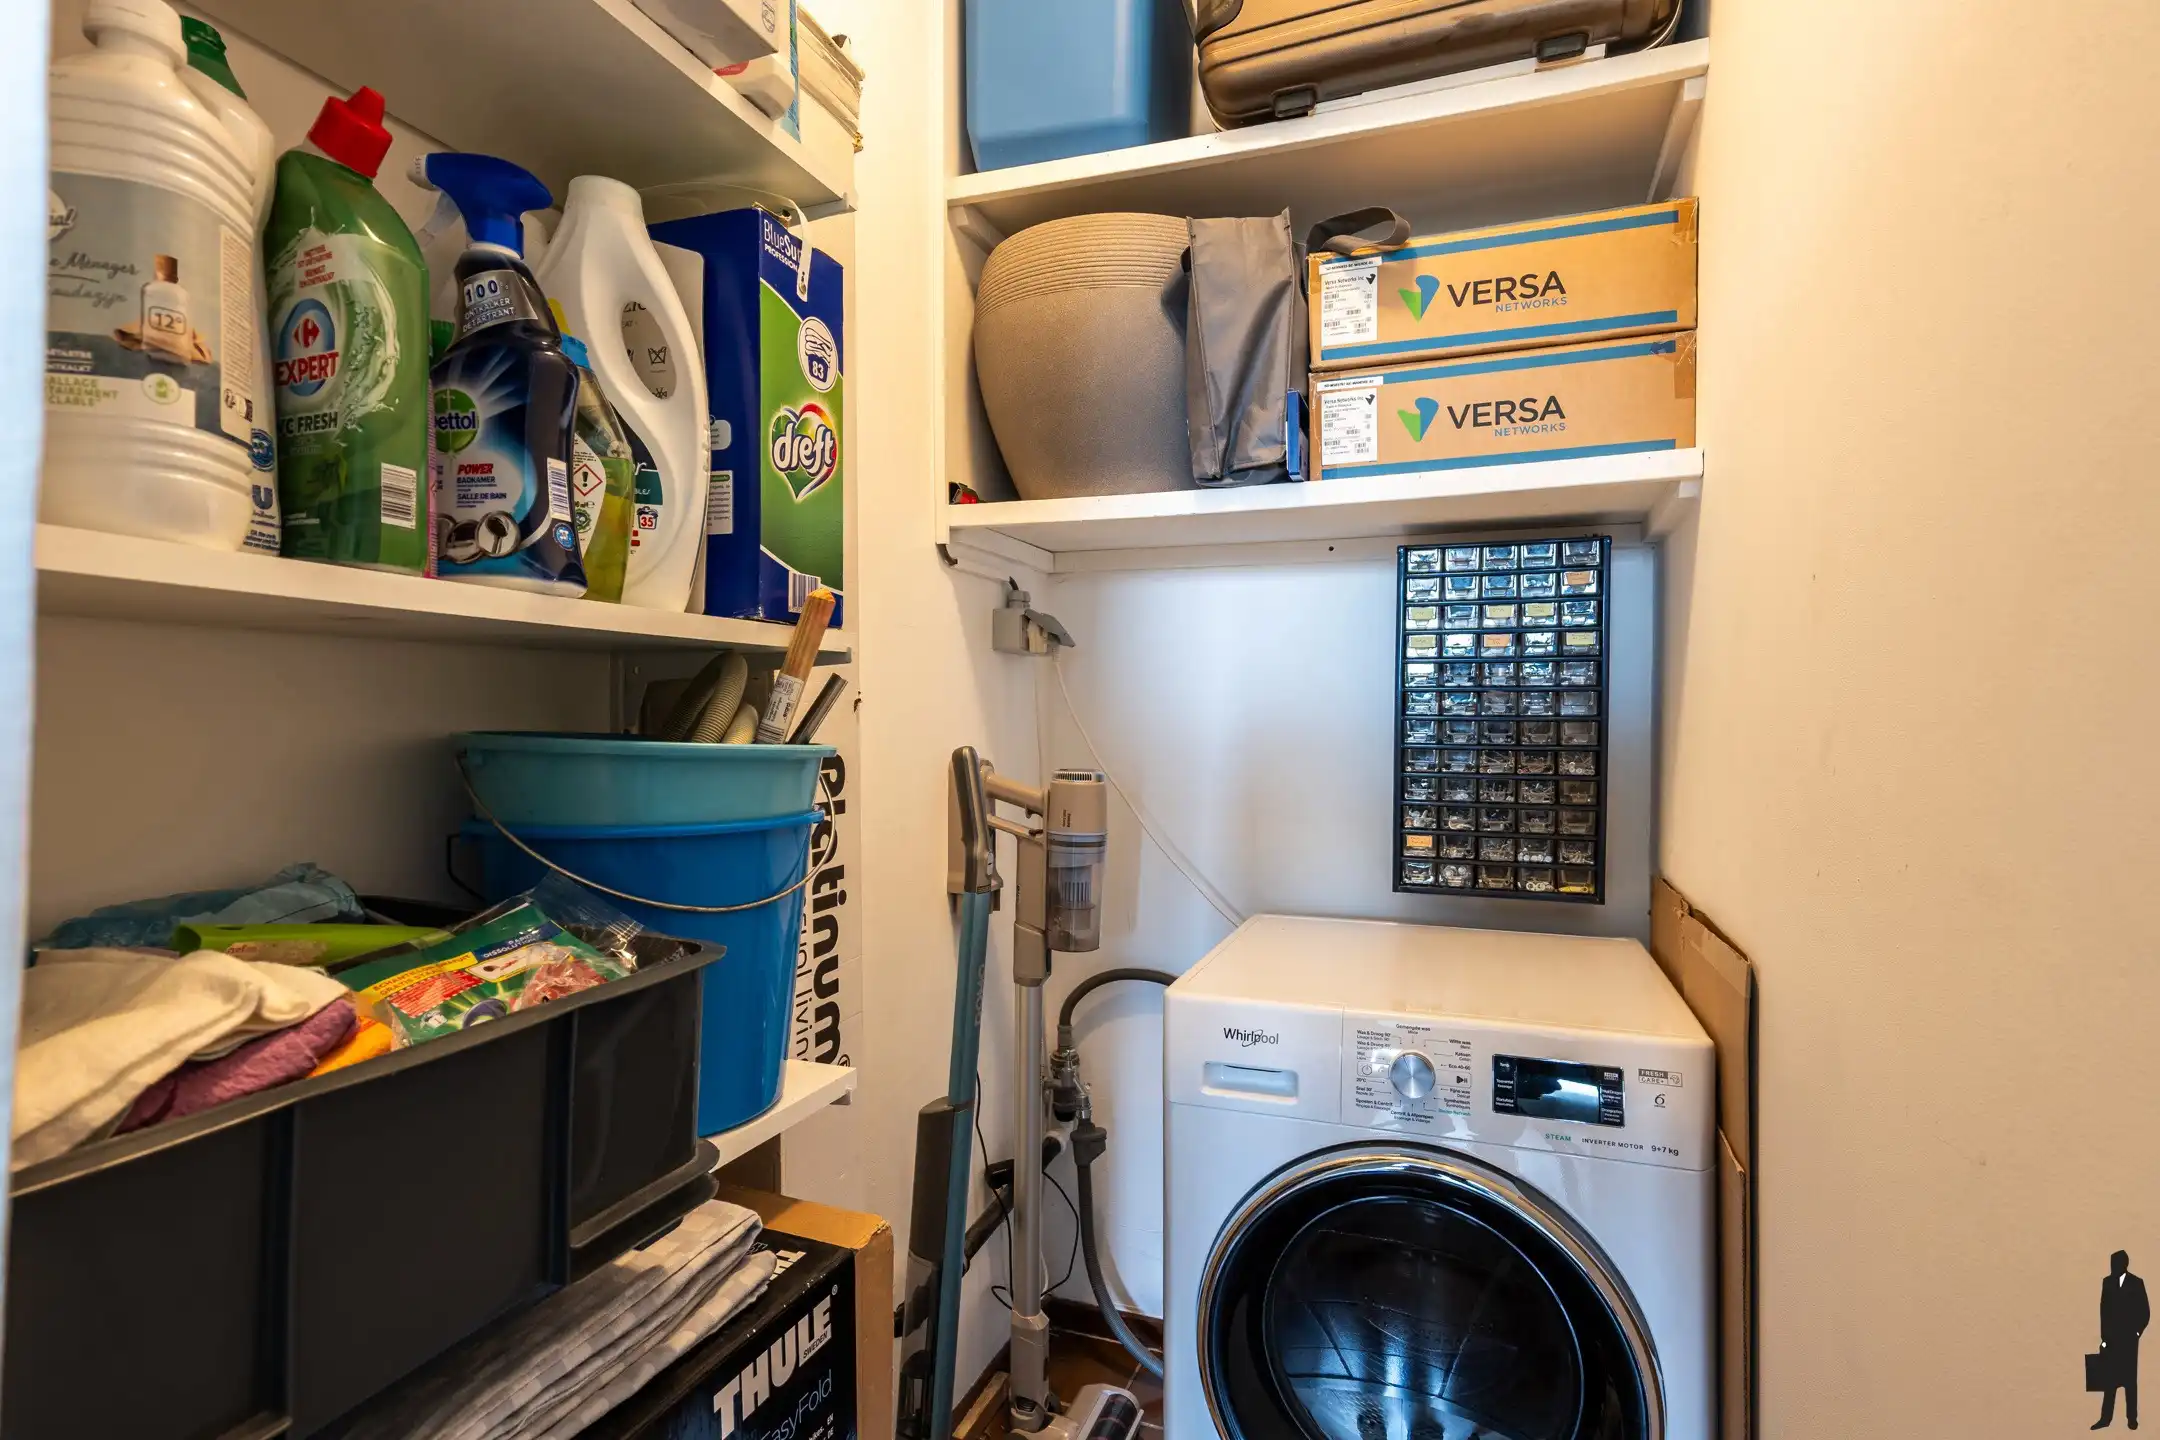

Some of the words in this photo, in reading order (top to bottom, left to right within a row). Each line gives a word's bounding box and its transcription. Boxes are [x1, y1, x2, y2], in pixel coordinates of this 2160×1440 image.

[1447, 270, 1567, 308] VERSA
[465, 297, 511, 320] ONTKALKER
[1495, 296, 1568, 313] NETWORKS
[276, 351, 339, 386] EXPERT
[811, 360, 824, 380] 83
[297, 411, 339, 433] FRESH
[1447, 395, 1567, 430] VERSA
[1494, 422, 1567, 437] NETWORKS
[772, 421, 835, 478] dreft
[457, 463, 494, 475] POWER
[641, 516, 654, 527] 35
[1223, 1027, 1279, 1047] Whirlpool
[1545, 1133, 1572, 1142] STEAM
[1582, 1138, 1616, 1147] INVERTER
[1618, 1142, 1644, 1150] MOTOR
[1651, 1144, 1667, 1153] 9+7
[1668, 1146, 1679, 1157] kg
[803, 1331, 828, 1360] SWEDEN
[713, 1295, 832, 1440] THULE
